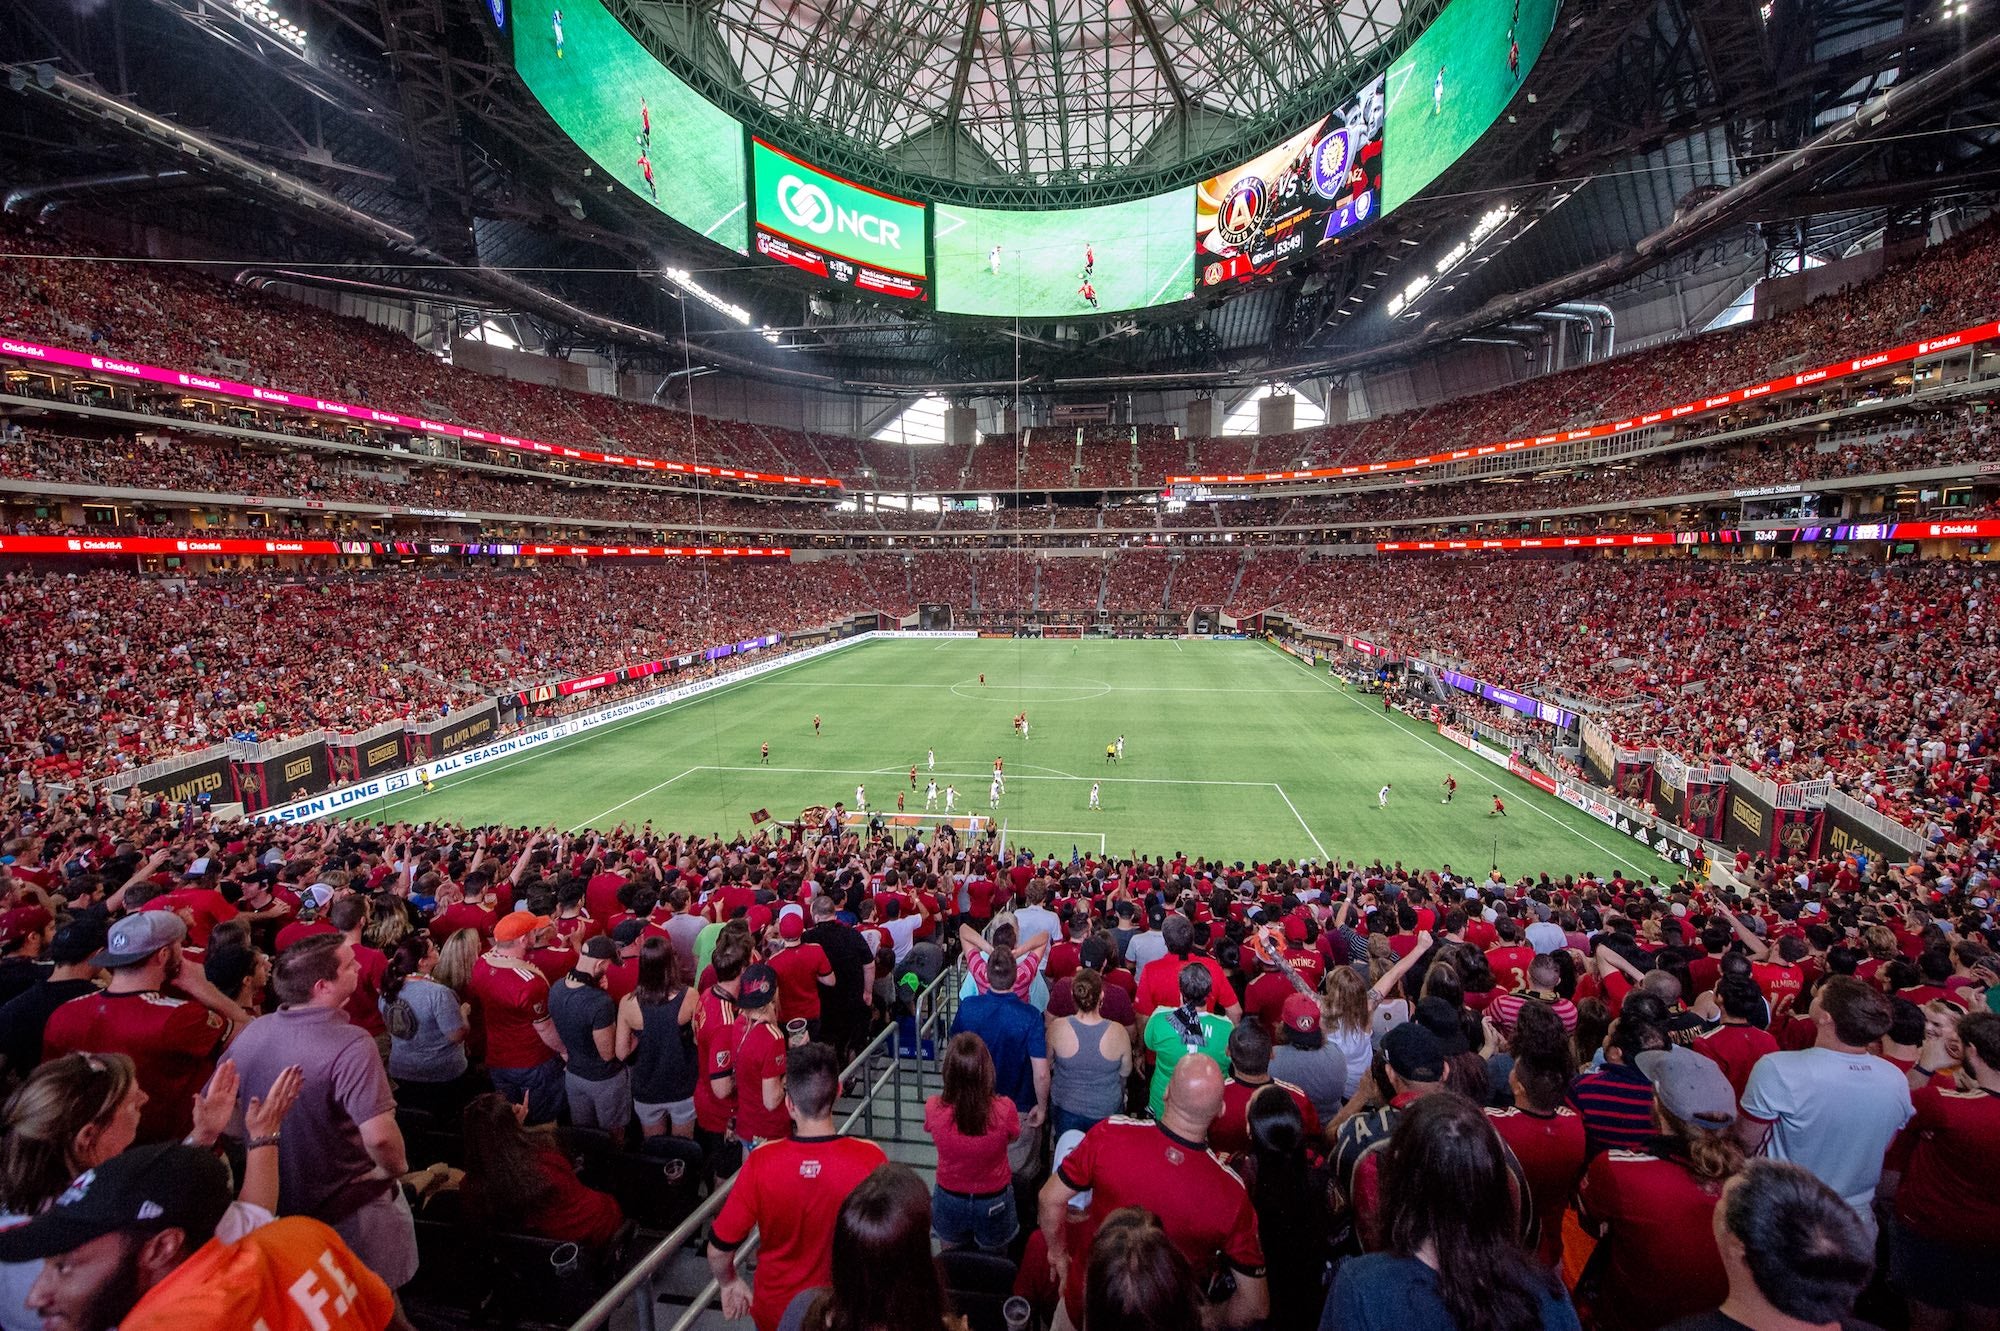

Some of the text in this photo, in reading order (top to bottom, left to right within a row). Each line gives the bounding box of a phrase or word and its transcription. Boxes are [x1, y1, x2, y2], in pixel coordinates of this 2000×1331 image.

[1225, 177, 1258, 203] ATLANTA
[1278, 170, 1299, 198] VS
[1228, 191, 1253, 232] A
[1340, 209, 1348, 228] 2
[837, 205, 902, 250] NCR
[1220, 216, 1260, 243] UNITED FC
[1262, 250, 1274, 259] NCR
[1277, 235, 1301, 255] 53:49
[1230, 260, 1236, 276] 1
[2, 342, 44, 357] Chick-fil-A
[105, 361, 140, 374] Chick-fil-A
[1733, 484, 1801, 498] Mercedes-Benz Stadium
[409, 507, 446, 517] Mercedes-Benz
[1754, 531, 1778, 540] 53:49
[1825, 528, 1831, 538] 2
[83, 541, 123, 550] Chick-fil-A
[430, 544, 450, 554] 53:49
[690, 681, 713, 692] SEASON
[582, 698, 656, 728] ALL SEASON LONG
[442, 719, 490, 750] ATLANTA UNITED
[370, 744, 396, 762] CONQUER
[434, 731, 549, 774] ALL SEASON LONG
[286, 762, 311, 778] UNITE
[170, 772, 223, 802] UNITED
[330, 784, 379, 807] LONG
[1735, 802, 1760, 832] CONQUER
[1508, 967, 1526, 995] 3
